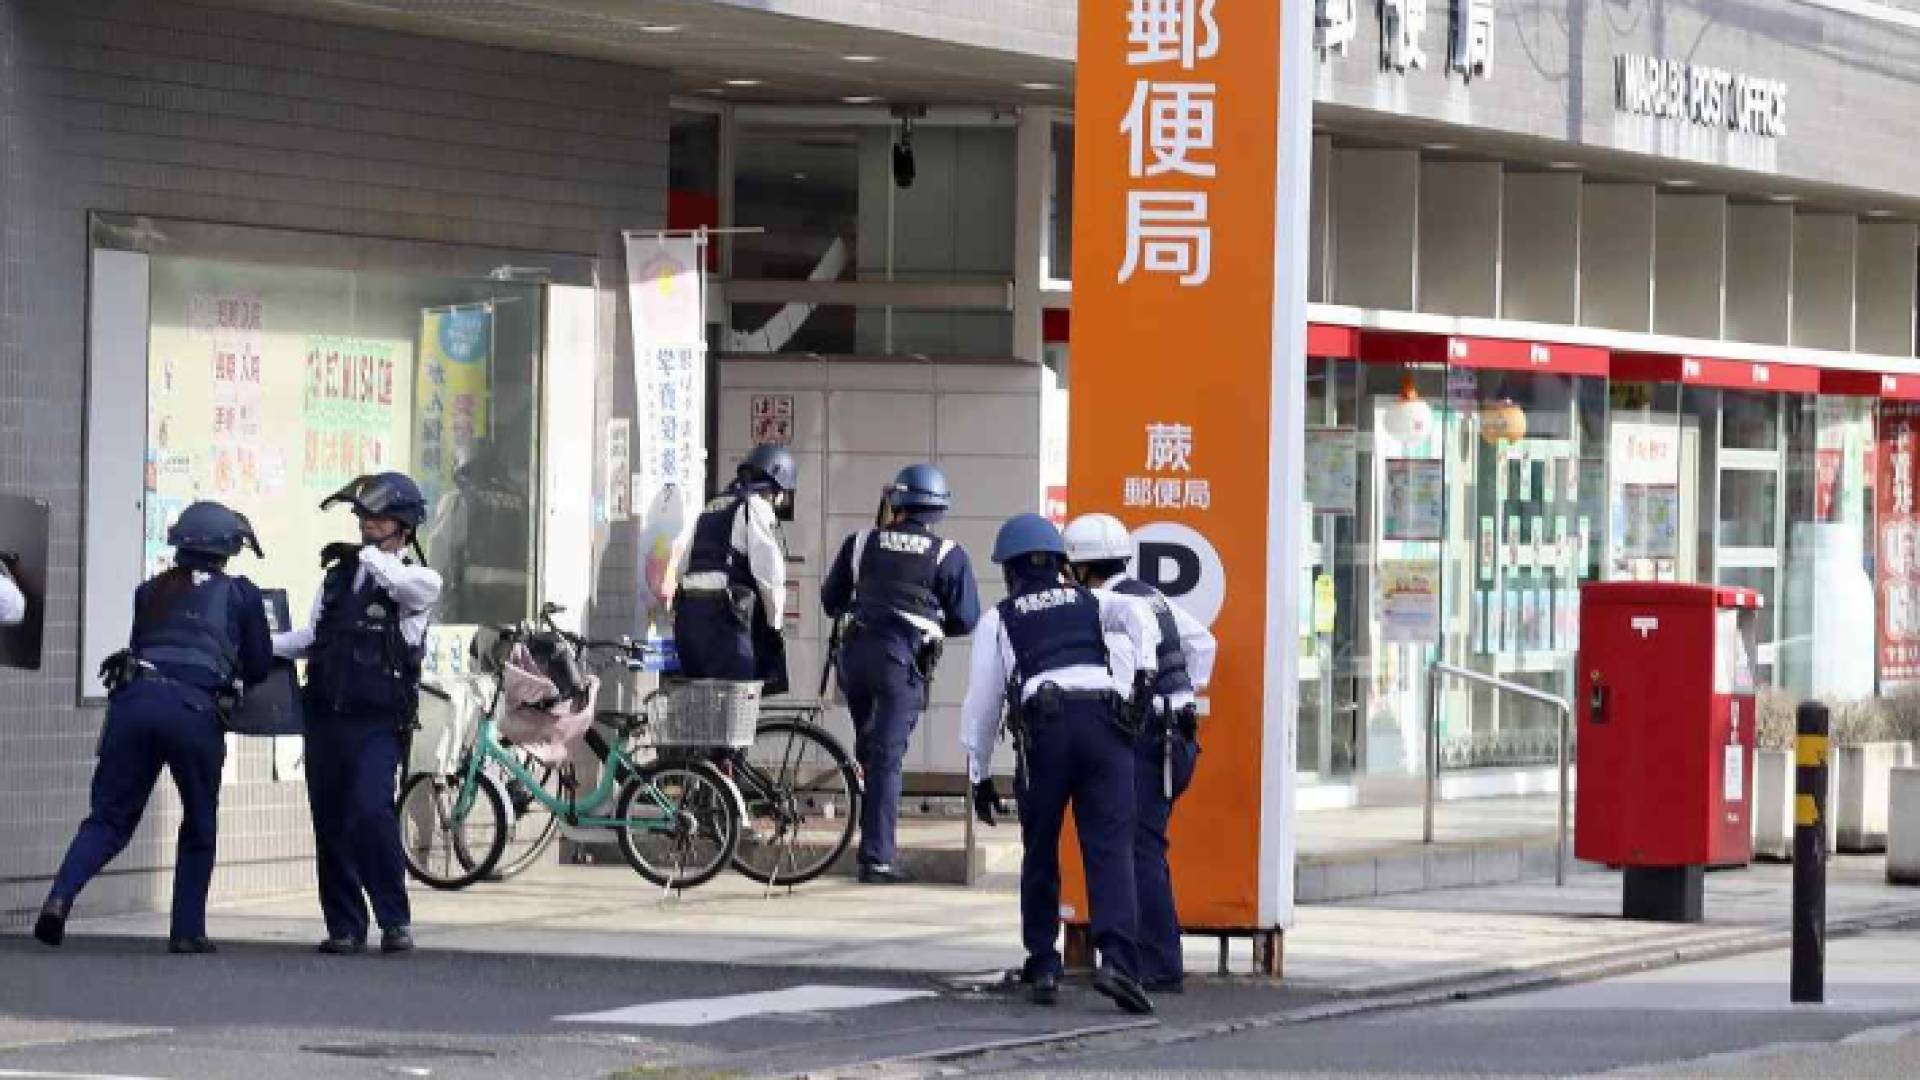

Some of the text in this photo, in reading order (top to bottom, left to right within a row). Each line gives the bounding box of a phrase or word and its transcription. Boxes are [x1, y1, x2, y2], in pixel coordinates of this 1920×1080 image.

[1689, 64, 1731, 127] POST
[1733, 73, 1787, 137] OFFICE
[1117, 0, 1220, 287] 郵便局
[1145, 422, 1193, 472] 蕨
[1123, 477, 1211, 510] 郵便局
